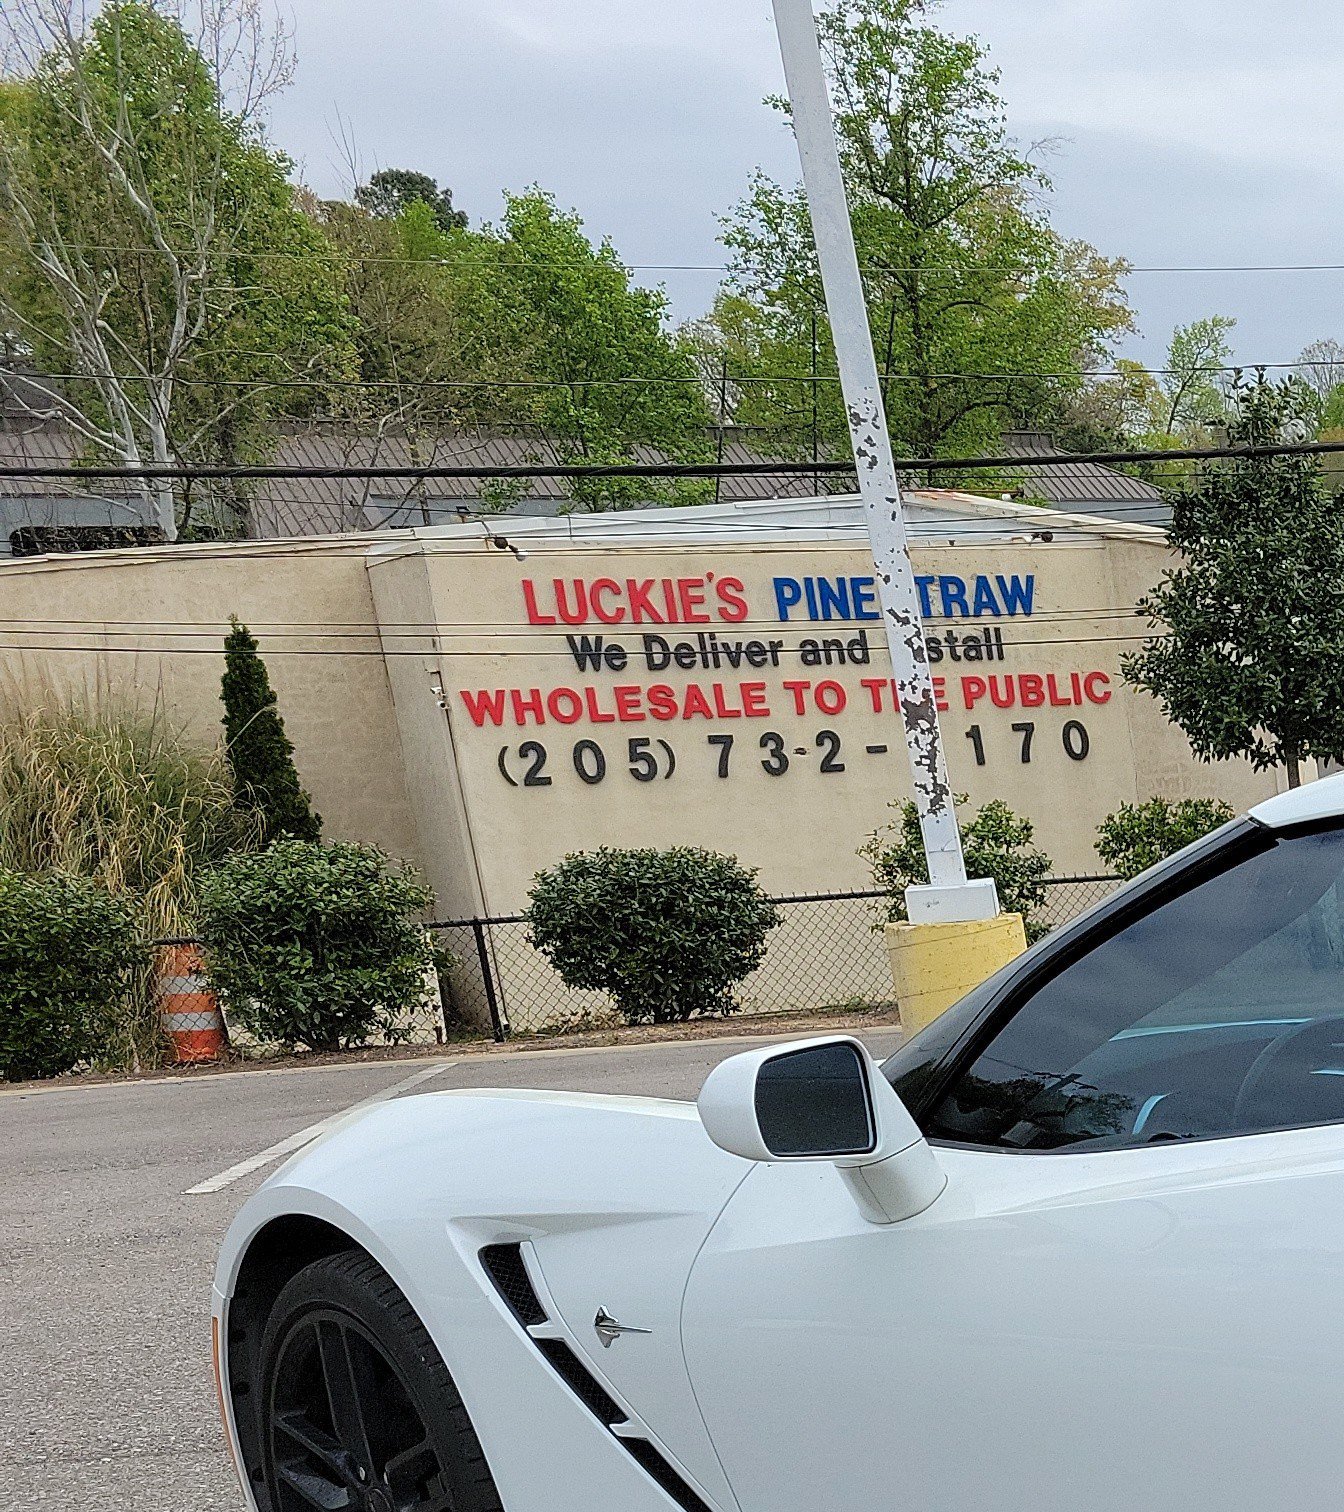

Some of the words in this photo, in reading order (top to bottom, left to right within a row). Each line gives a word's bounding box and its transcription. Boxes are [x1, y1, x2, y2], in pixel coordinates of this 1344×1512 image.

[522, 571, 749, 625] LUCKIE'S
[773, 576, 880, 621] PINE
[914, 575, 1035, 618] TRAW
[566, 634, 628, 672] We
[642, 632, 784, 672] Deliver
[799, 629, 870, 665] and
[925, 626, 1006, 662] stall
[459, 681, 770, 727] WHOLESALE
[783, 680, 848, 716] TO
[861, 677, 949, 713] TE
[960, 671, 1113, 710] PUBLIC
